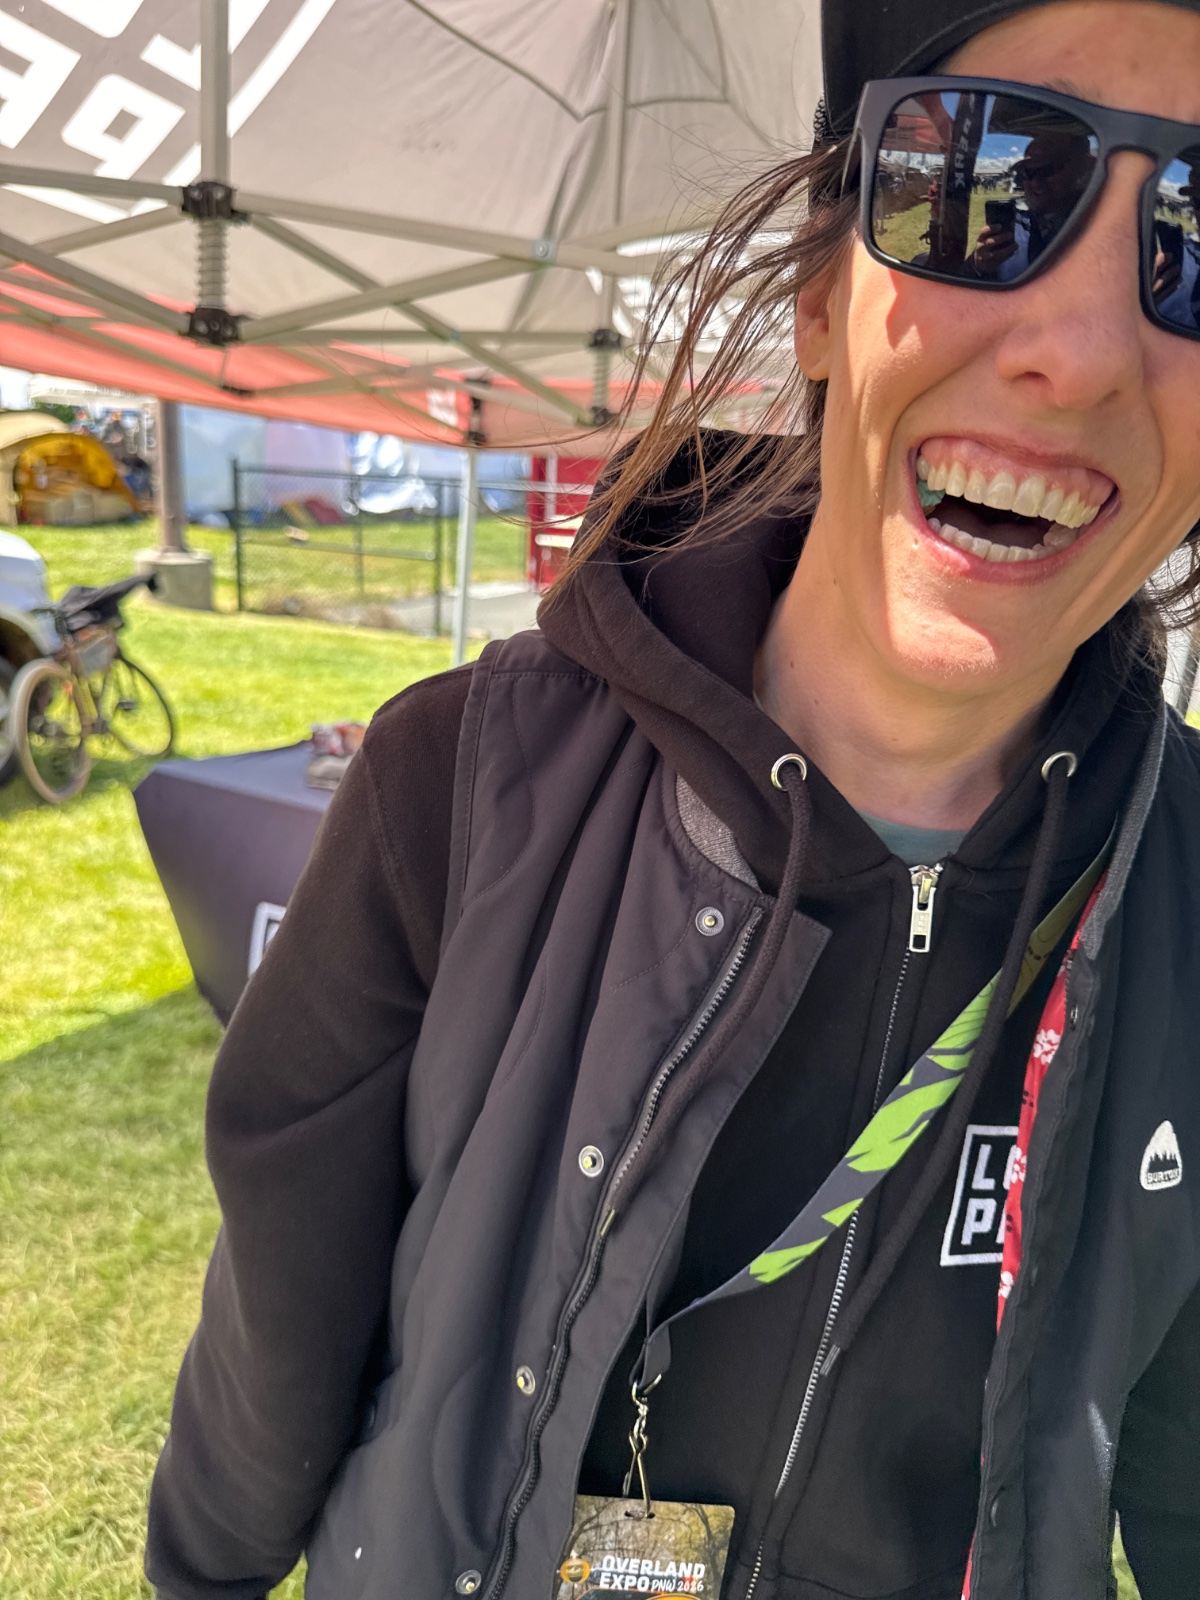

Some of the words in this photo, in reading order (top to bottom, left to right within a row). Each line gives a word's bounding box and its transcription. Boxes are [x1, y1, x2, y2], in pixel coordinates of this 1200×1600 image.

[602, 1555, 706, 1579] OVERLAND
[599, 1572, 649, 1591] EXPO
[651, 1578, 676, 1592] PNW
[677, 1580, 704, 1593] 2026
